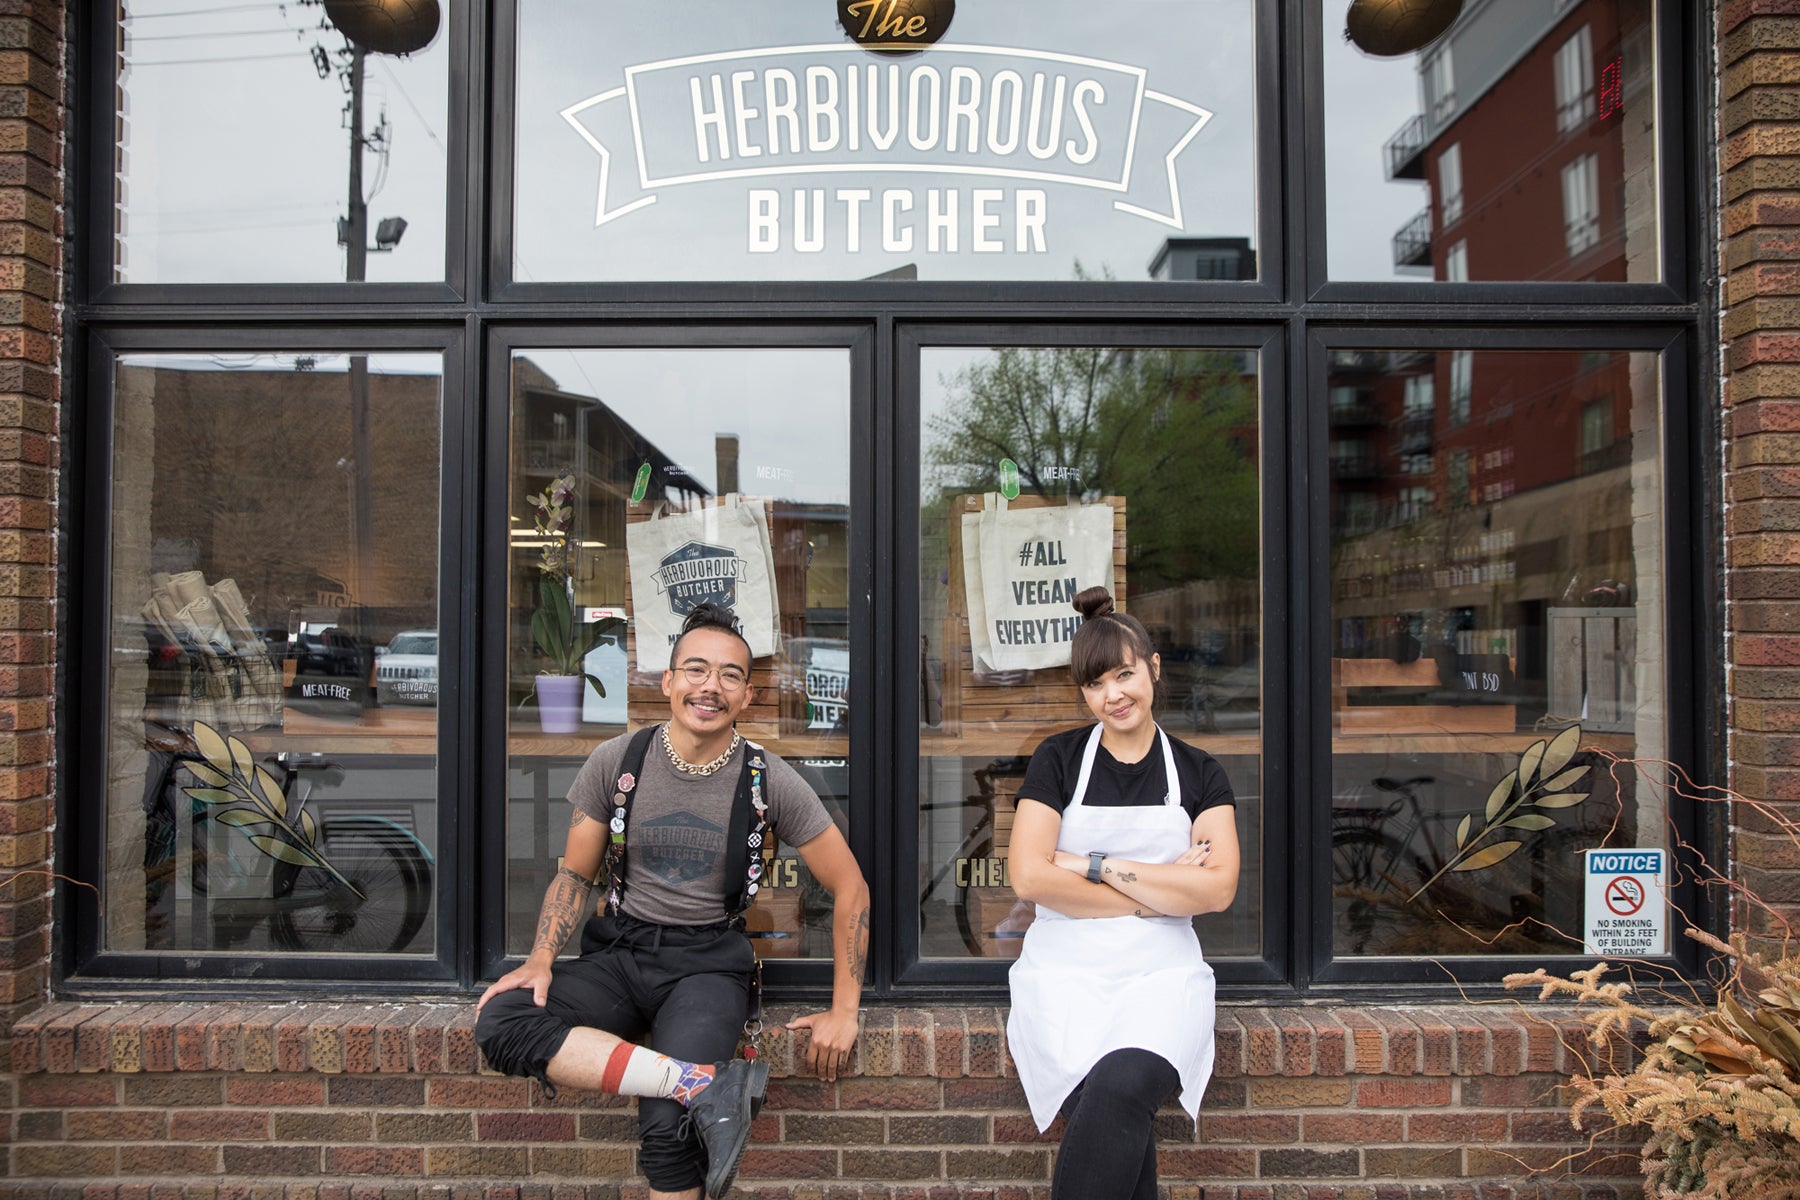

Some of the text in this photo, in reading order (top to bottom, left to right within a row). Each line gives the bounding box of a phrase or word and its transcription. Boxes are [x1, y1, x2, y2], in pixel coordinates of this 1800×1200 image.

[847, 0, 928, 38] The
[689, 64, 1105, 164] HERBIVOROUS
[749, 189, 1047, 253] BUTCHER
[1019, 540, 1067, 567] #ALL
[660, 558, 737, 585] HERBIVOROUS
[677, 579, 725, 597] BUTCHER
[1011, 577, 1077, 606] VEGAN
[995, 615, 1084, 645] EVERYTHI
[302, 683, 352, 701] MEAT-FREE
[1592, 855, 1659, 871] NOTICE
[1592, 929, 1658, 937] WITHIN 25 FEET
[1597, 919, 1652, 928] NO SMOKING
[1598, 939, 1652, 947] OF BUILDING
